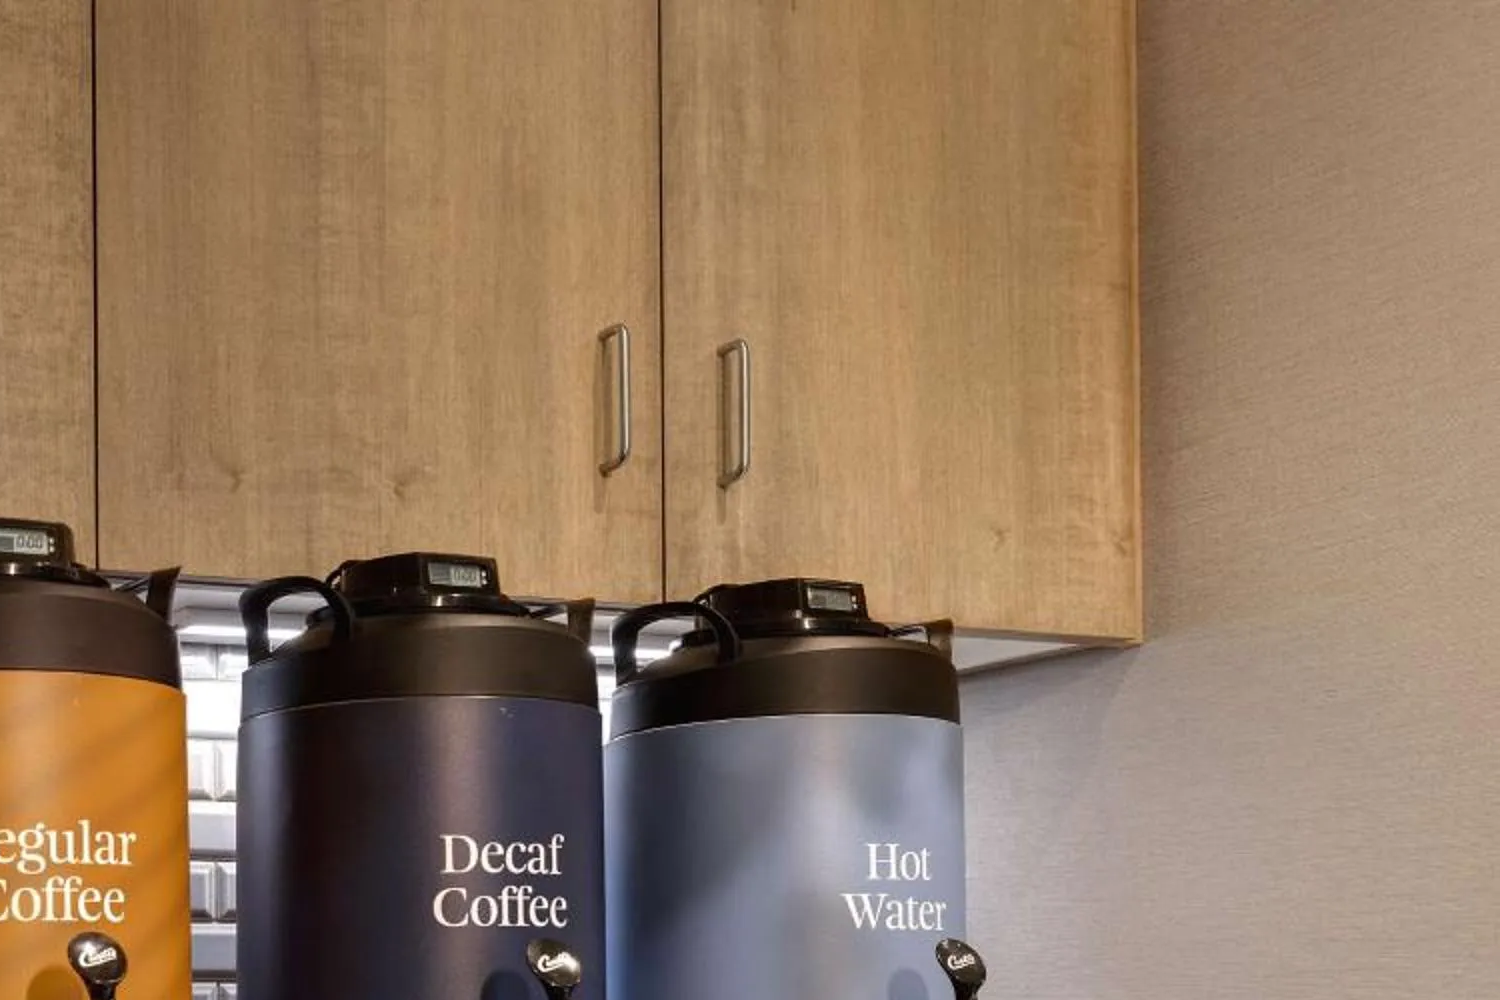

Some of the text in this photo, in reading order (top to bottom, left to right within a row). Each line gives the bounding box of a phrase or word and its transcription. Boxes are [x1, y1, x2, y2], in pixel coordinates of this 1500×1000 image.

[440, 834, 565, 875] Decaf
[865, 843, 932, 881] Hot
[433, 885, 567, 928] Coffee
[840, 893, 947, 931] Water
